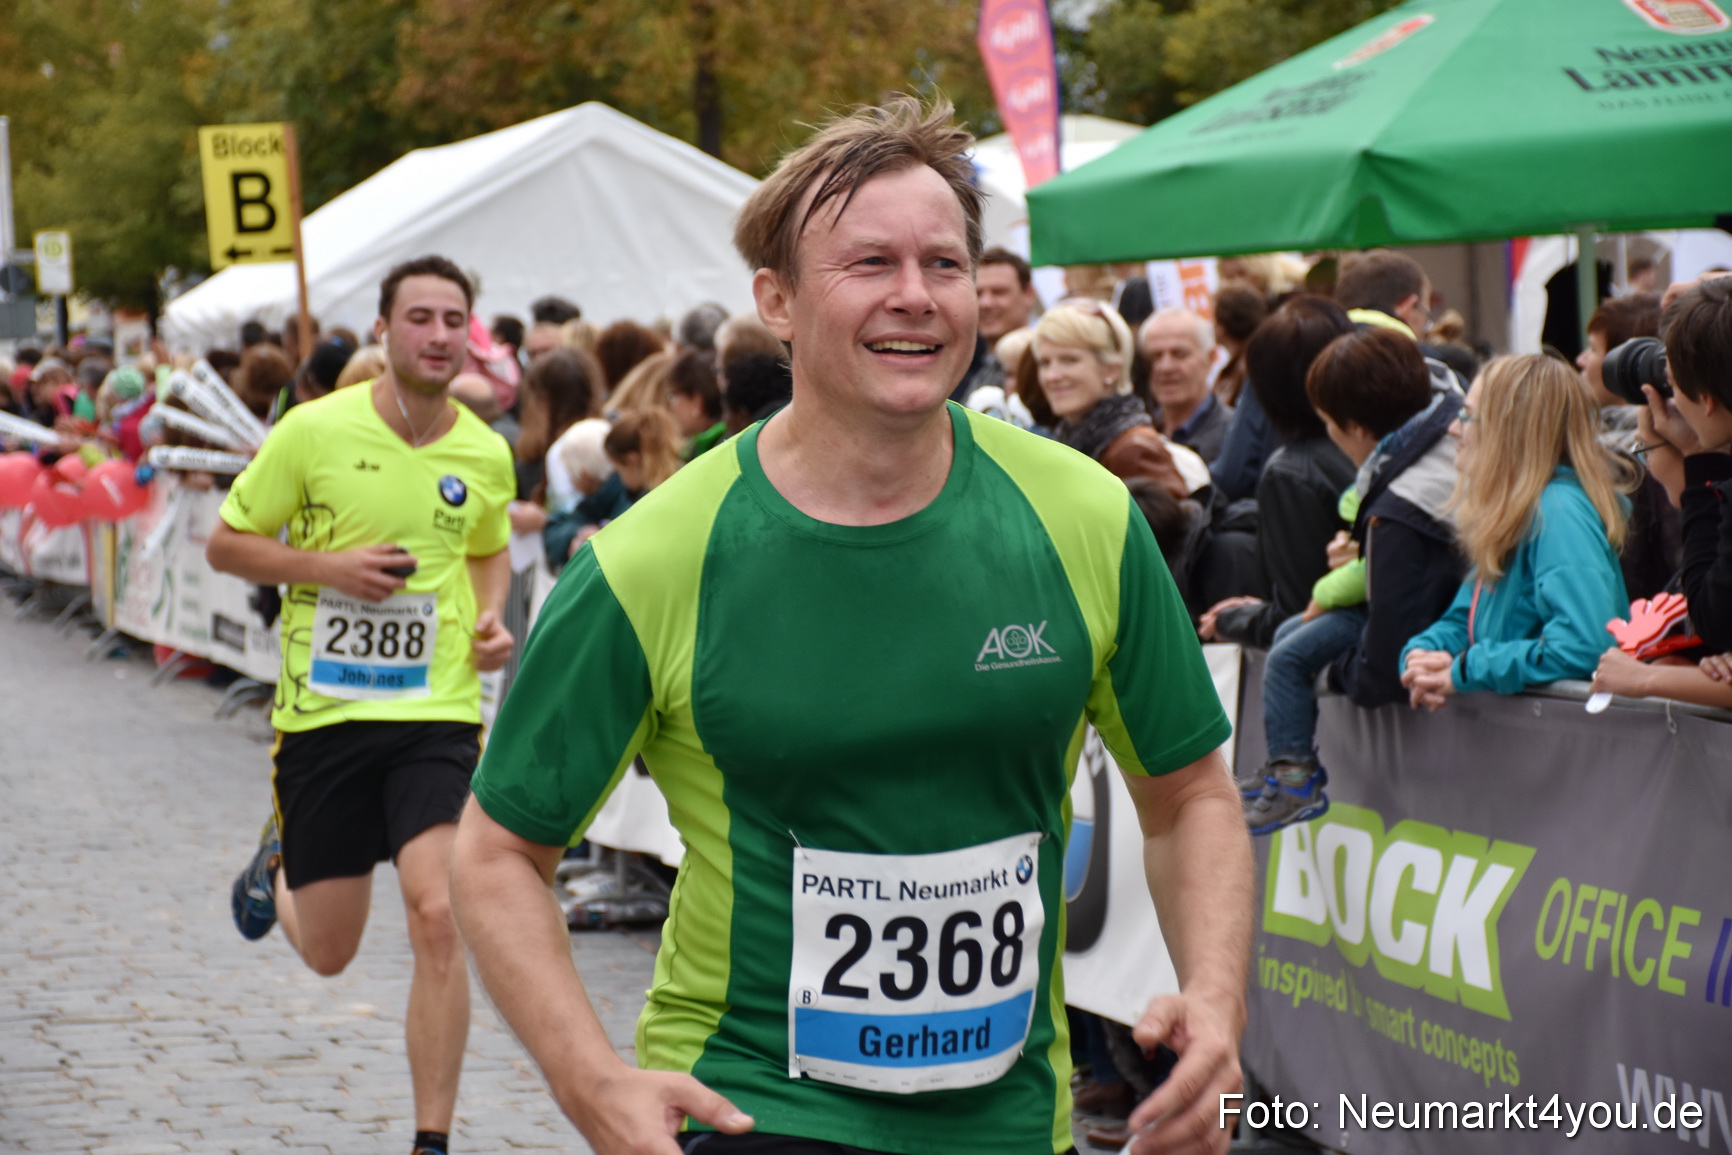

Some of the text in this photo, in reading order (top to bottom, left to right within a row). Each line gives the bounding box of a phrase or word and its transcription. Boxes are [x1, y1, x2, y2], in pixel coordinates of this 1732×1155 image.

[1593, 38, 1732, 67] Neum
[211, 131, 285, 160] Block
[231, 171, 276, 234] B
[321, 598, 419, 617] PARTL Neumarkt
[325, 616, 426, 660] 2388
[976, 620, 1057, 663] AOK
[974, 663, 991, 672] Die
[802, 868, 1009, 901] PARTL Neumarkt
[1273, 820, 1516, 992] BOCK
[821, 900, 1025, 1002] 2368
[1535, 877, 1702, 996] OFFICE
[802, 990, 812, 1005] B
[858, 1016, 992, 1058] Gerhard
[1421, 1019, 1520, 1088] concepts
